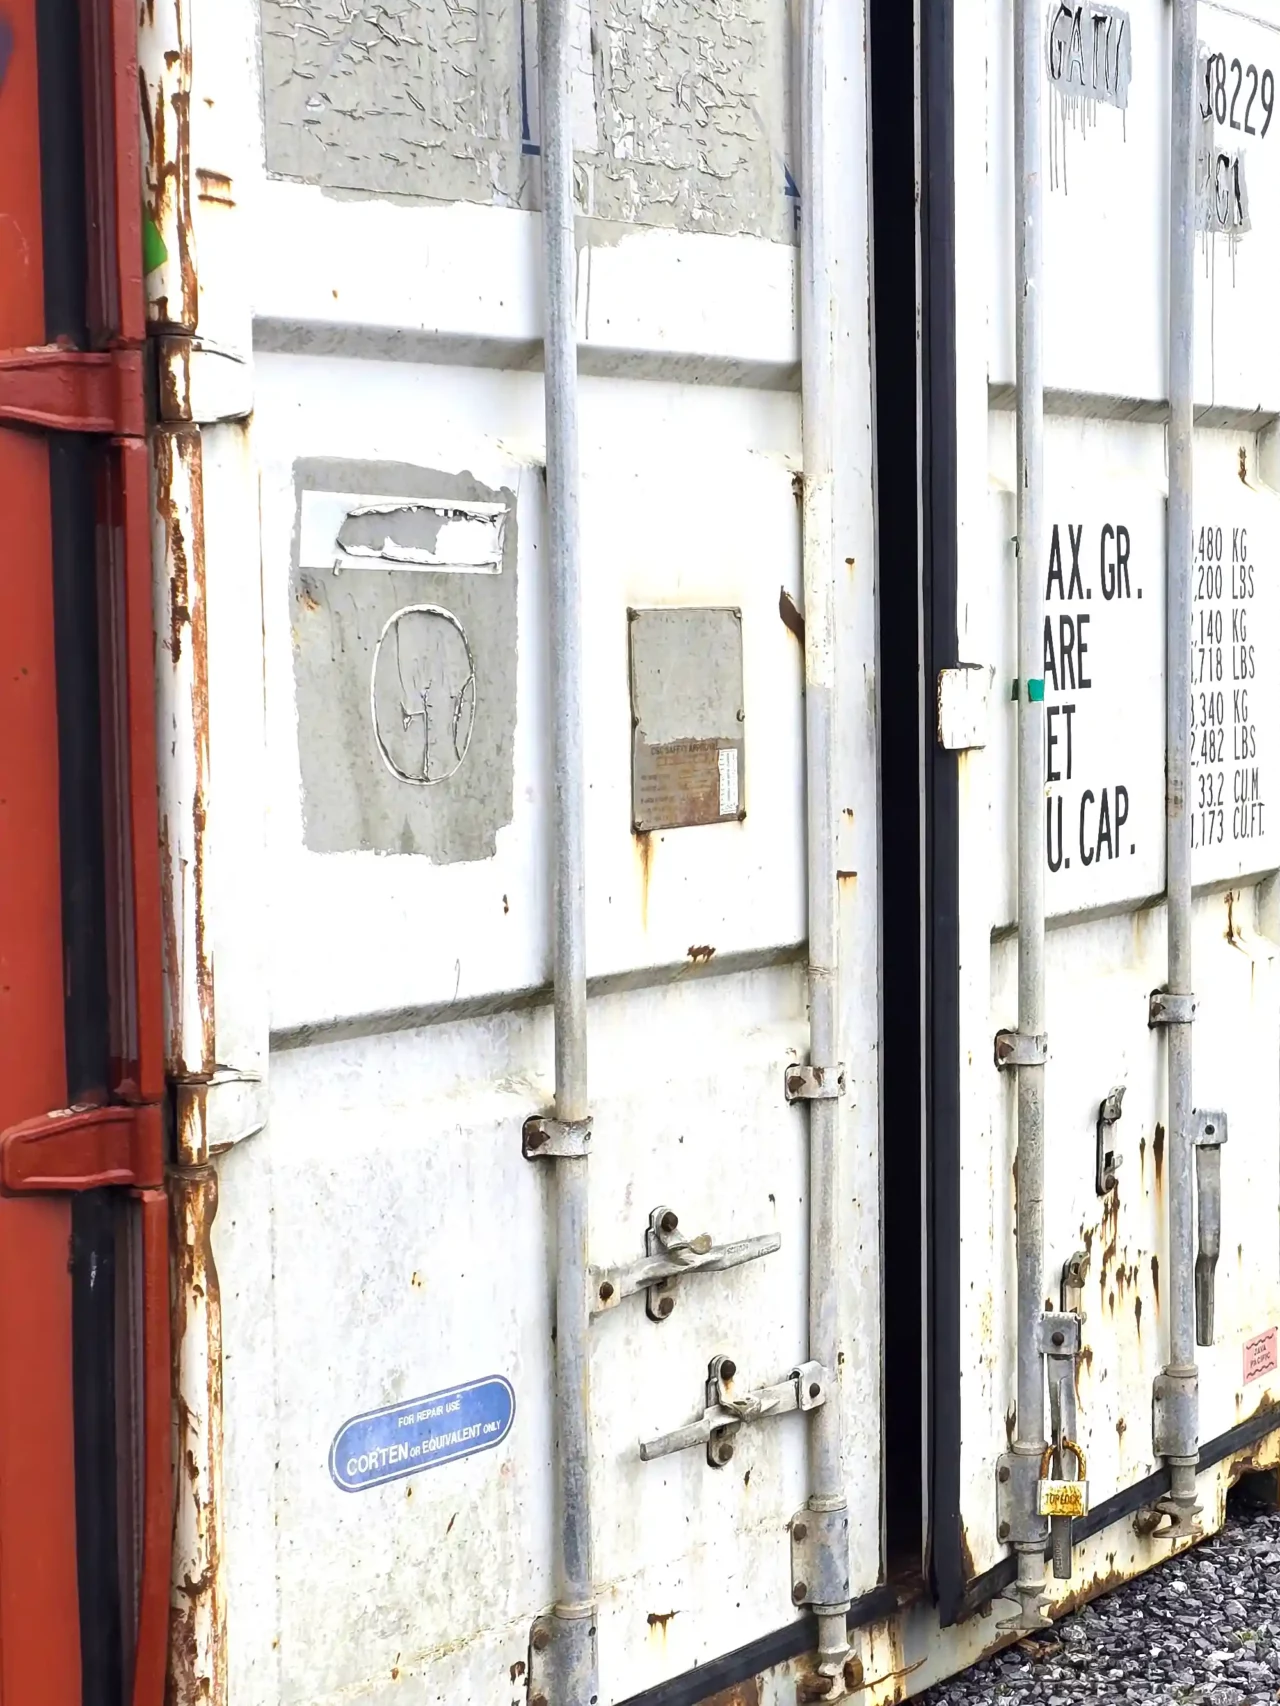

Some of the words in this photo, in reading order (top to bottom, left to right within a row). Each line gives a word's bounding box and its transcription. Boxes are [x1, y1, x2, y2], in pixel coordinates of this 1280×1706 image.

[1045, 524, 1092, 601] AX.
[1101, 522, 1143, 601] GR.
[1192, 526, 1223, 563] ,480
[1232, 527, 1247, 563] KG
[1191, 565, 1223, 602] ,200
[1232, 565, 1255, 600] LBS
[1190, 608, 1223, 648] ,140
[1232, 608, 1247, 644] KG
[1044, 613, 1092, 692] ARE
[1233, 645, 1255, 681] LBS
[1233, 688, 1248, 724] KG
[1047, 703, 1076, 783] ET
[1234, 724, 1256, 761] LBS
[1198, 771, 1225, 809] 33.2
[1079, 784, 1136, 867] CAP.
[1190, 808, 1224, 850] 1,173
[398, 1416, 415, 1429] FOR
[416, 1406, 444, 1423] REPAIR
[445, 1399, 461, 1414] USE
[346, 1441, 409, 1476] CORTEN
[410, 1445, 421, 1458] OR
[422, 1423, 482, 1454] EQUIVALENT
[483, 1419, 501, 1434] ONLY
